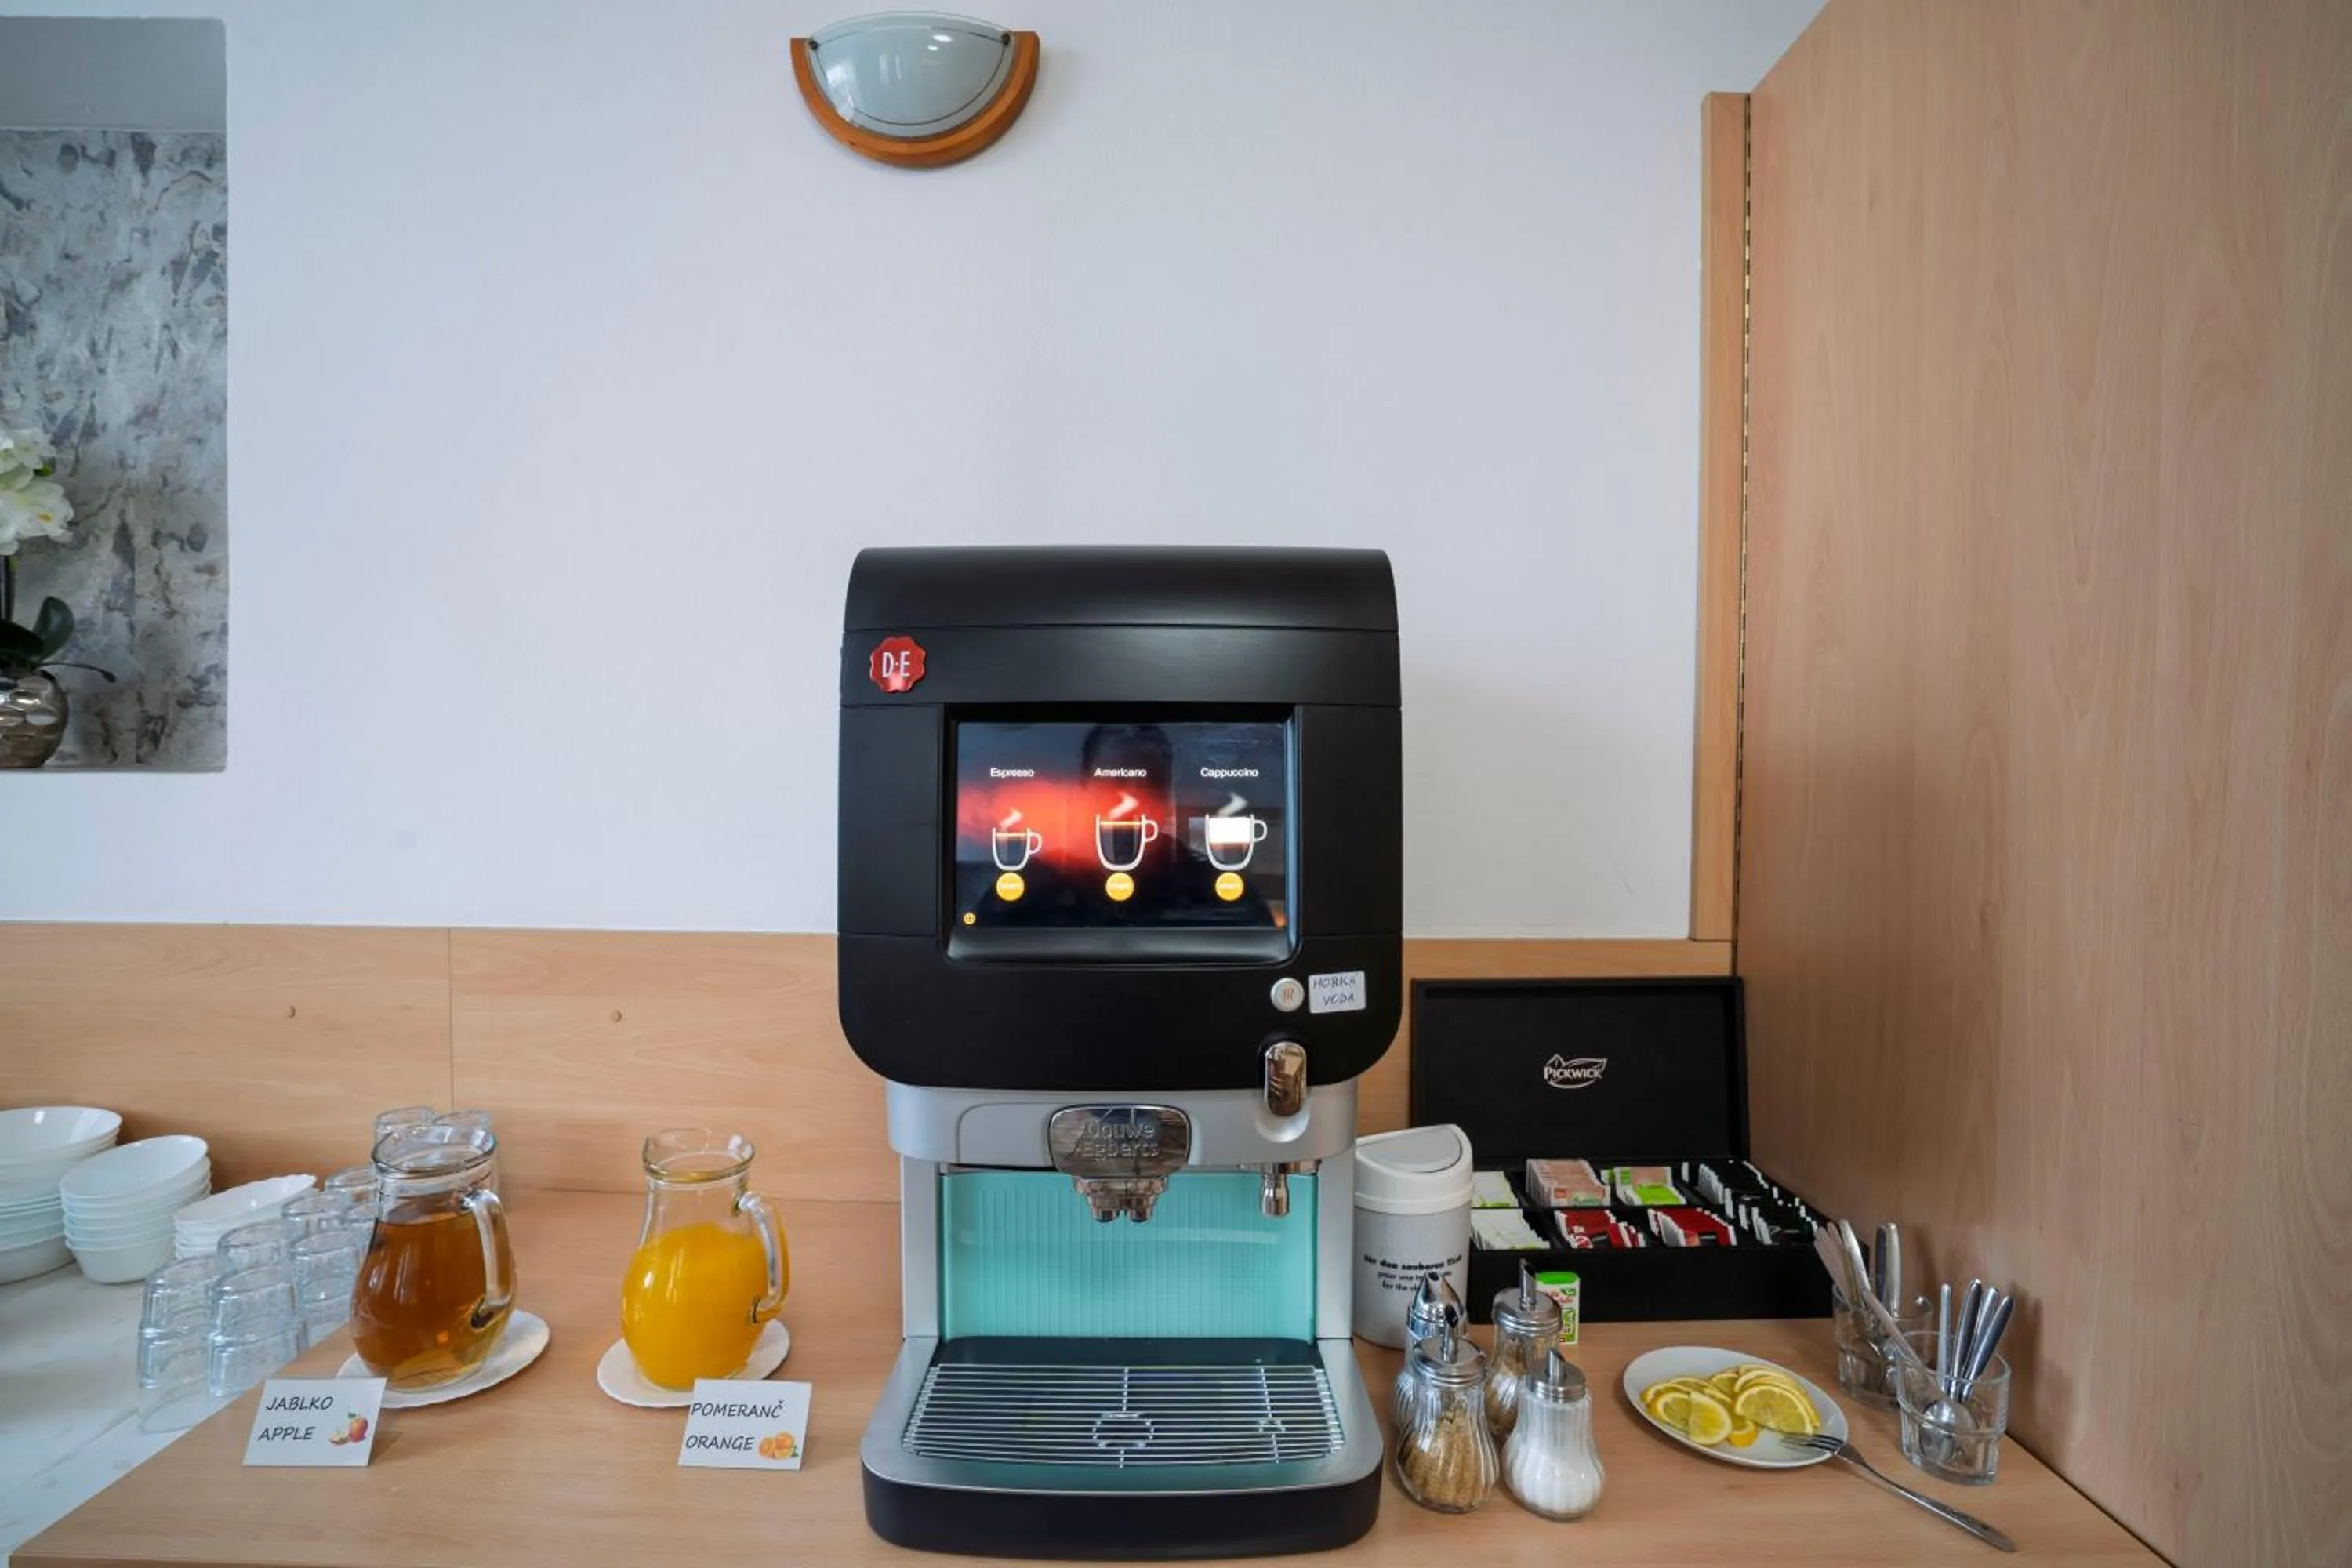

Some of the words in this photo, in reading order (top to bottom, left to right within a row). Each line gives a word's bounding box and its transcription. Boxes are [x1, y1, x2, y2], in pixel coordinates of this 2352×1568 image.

[989, 768, 1035, 779] Espresso
[1094, 767, 1147, 778] Americano
[1200, 767, 1258, 779] Cappuccino
[266, 1396, 334, 1410] JABLKO
[691, 1399, 785, 1419] POMERANČ
[258, 1426, 316, 1441] APPLE
[685, 1435, 755, 1451] ORANGE
